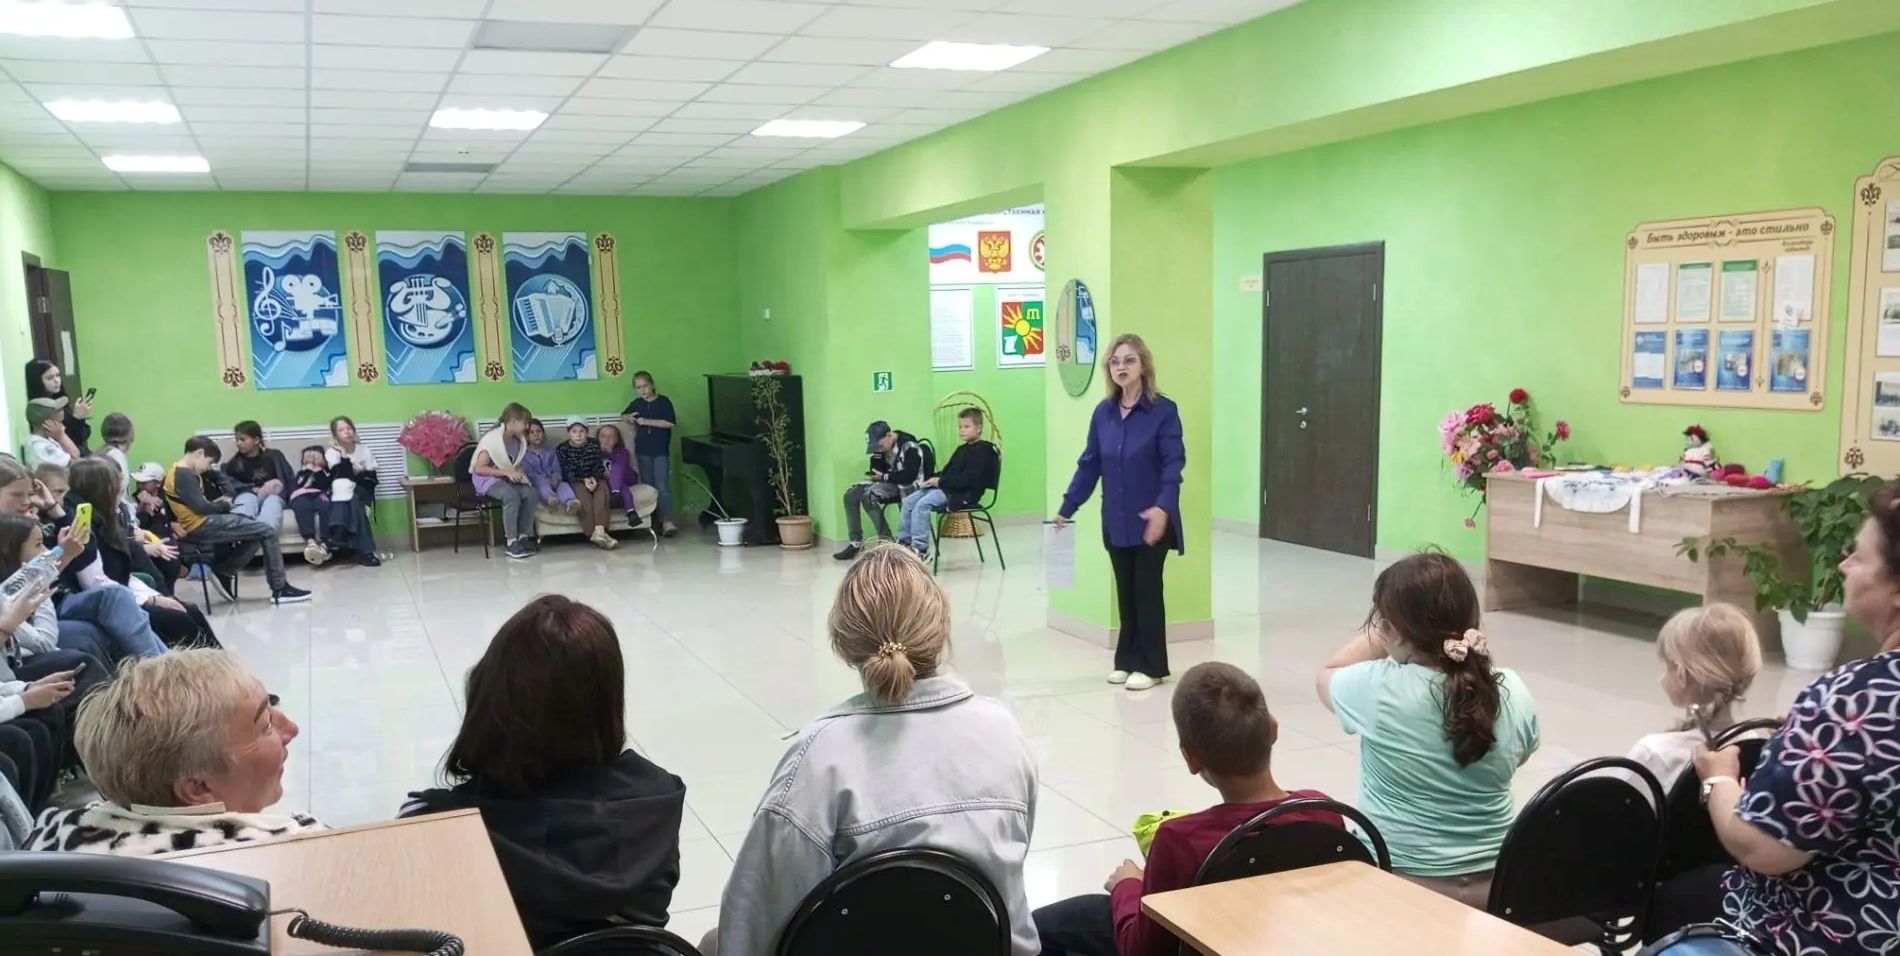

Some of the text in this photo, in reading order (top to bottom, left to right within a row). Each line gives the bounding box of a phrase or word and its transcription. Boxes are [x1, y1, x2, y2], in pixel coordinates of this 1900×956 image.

[1646, 232, 1674, 243] Быть
[1677, 229, 1726, 242] здоровым
[1736, 227, 1758, 237] это
[1759, 223, 1810, 235] стильно
